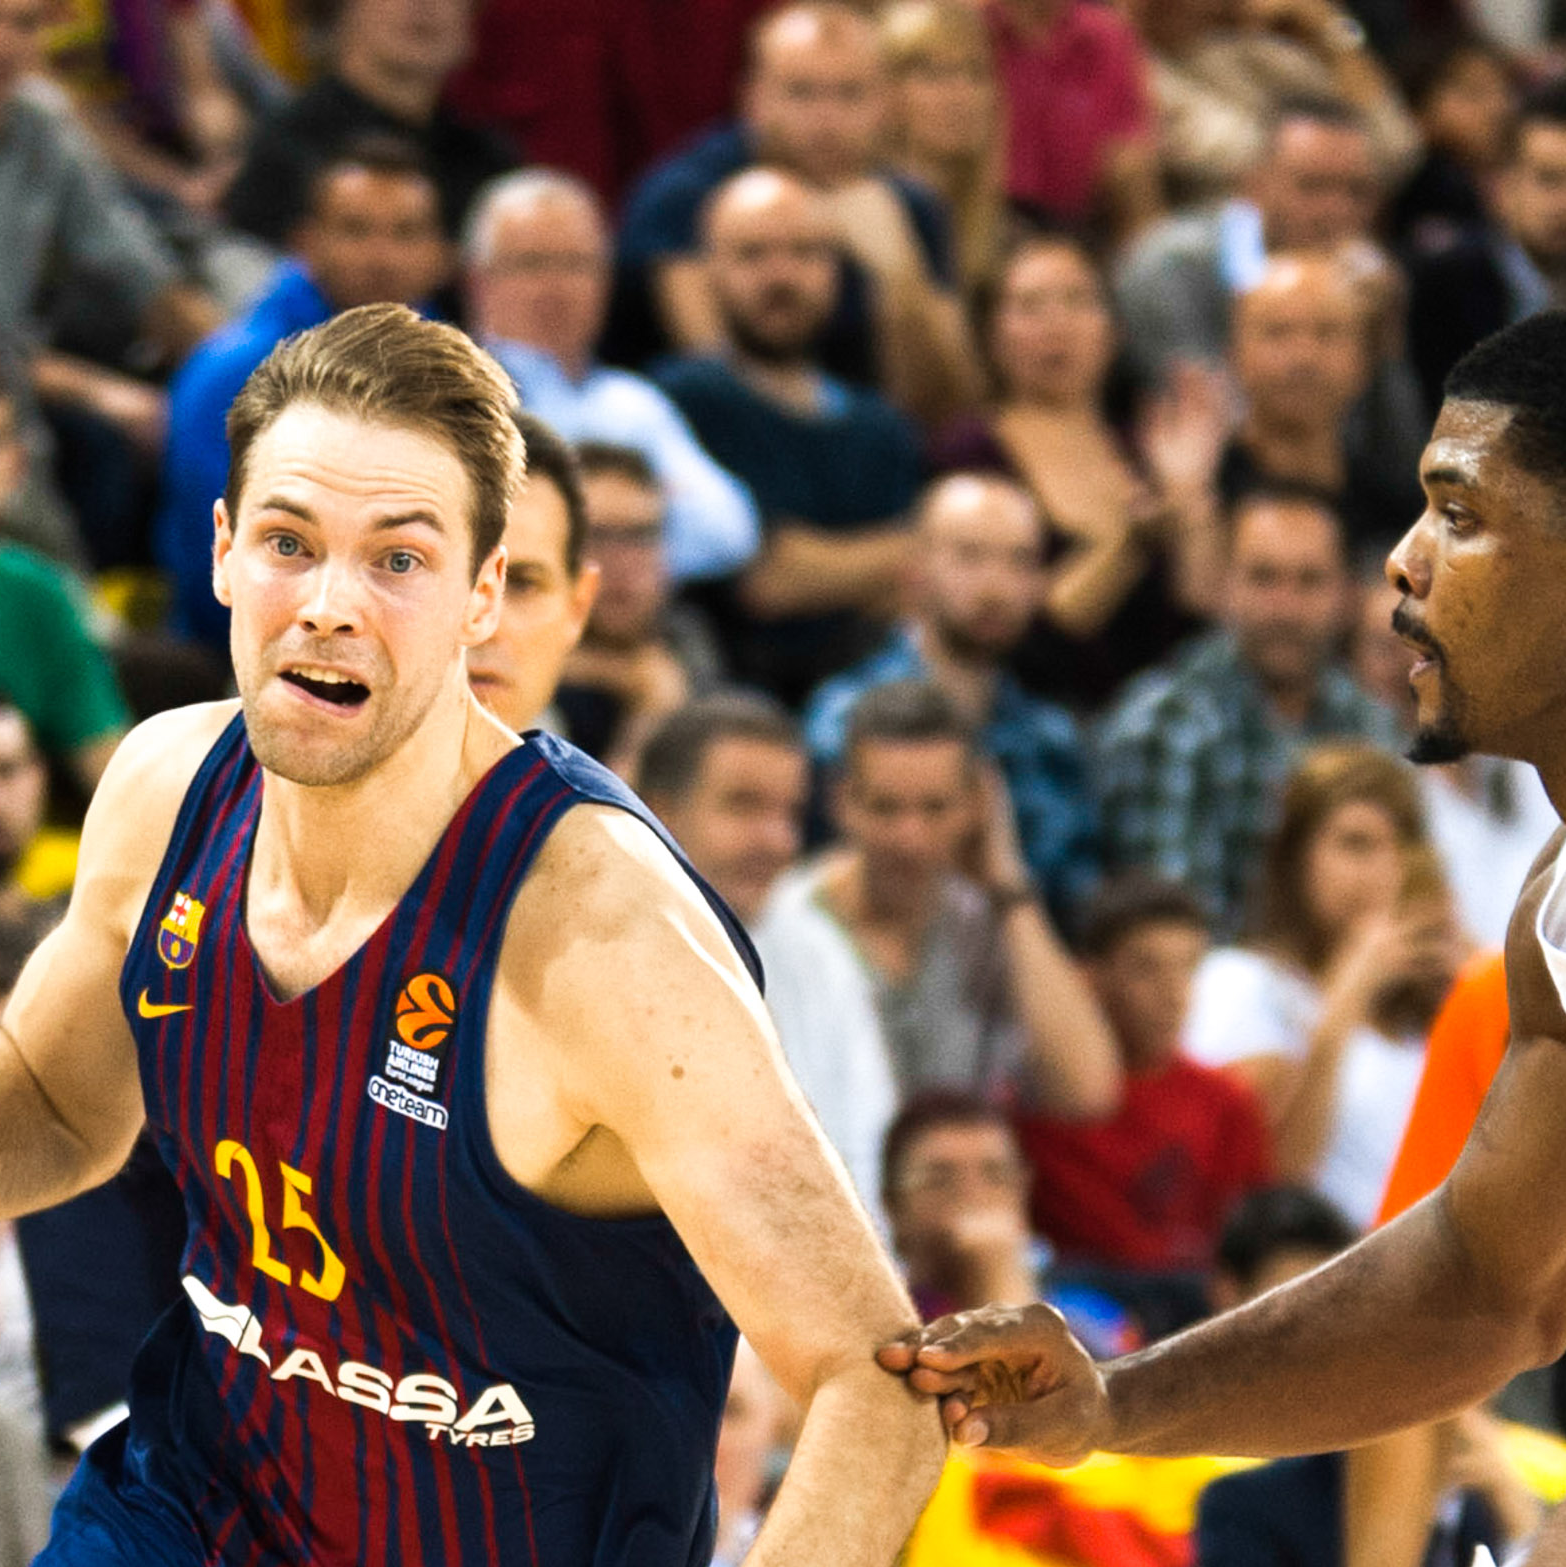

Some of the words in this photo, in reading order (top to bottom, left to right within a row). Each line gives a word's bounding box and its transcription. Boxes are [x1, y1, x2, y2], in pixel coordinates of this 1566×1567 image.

[389, 1039, 440, 1071] TURKISH
[214, 1138, 347, 1302] 25
[207, 1295, 534, 1432] LASSA
[424, 1421, 535, 1448] TYRES
